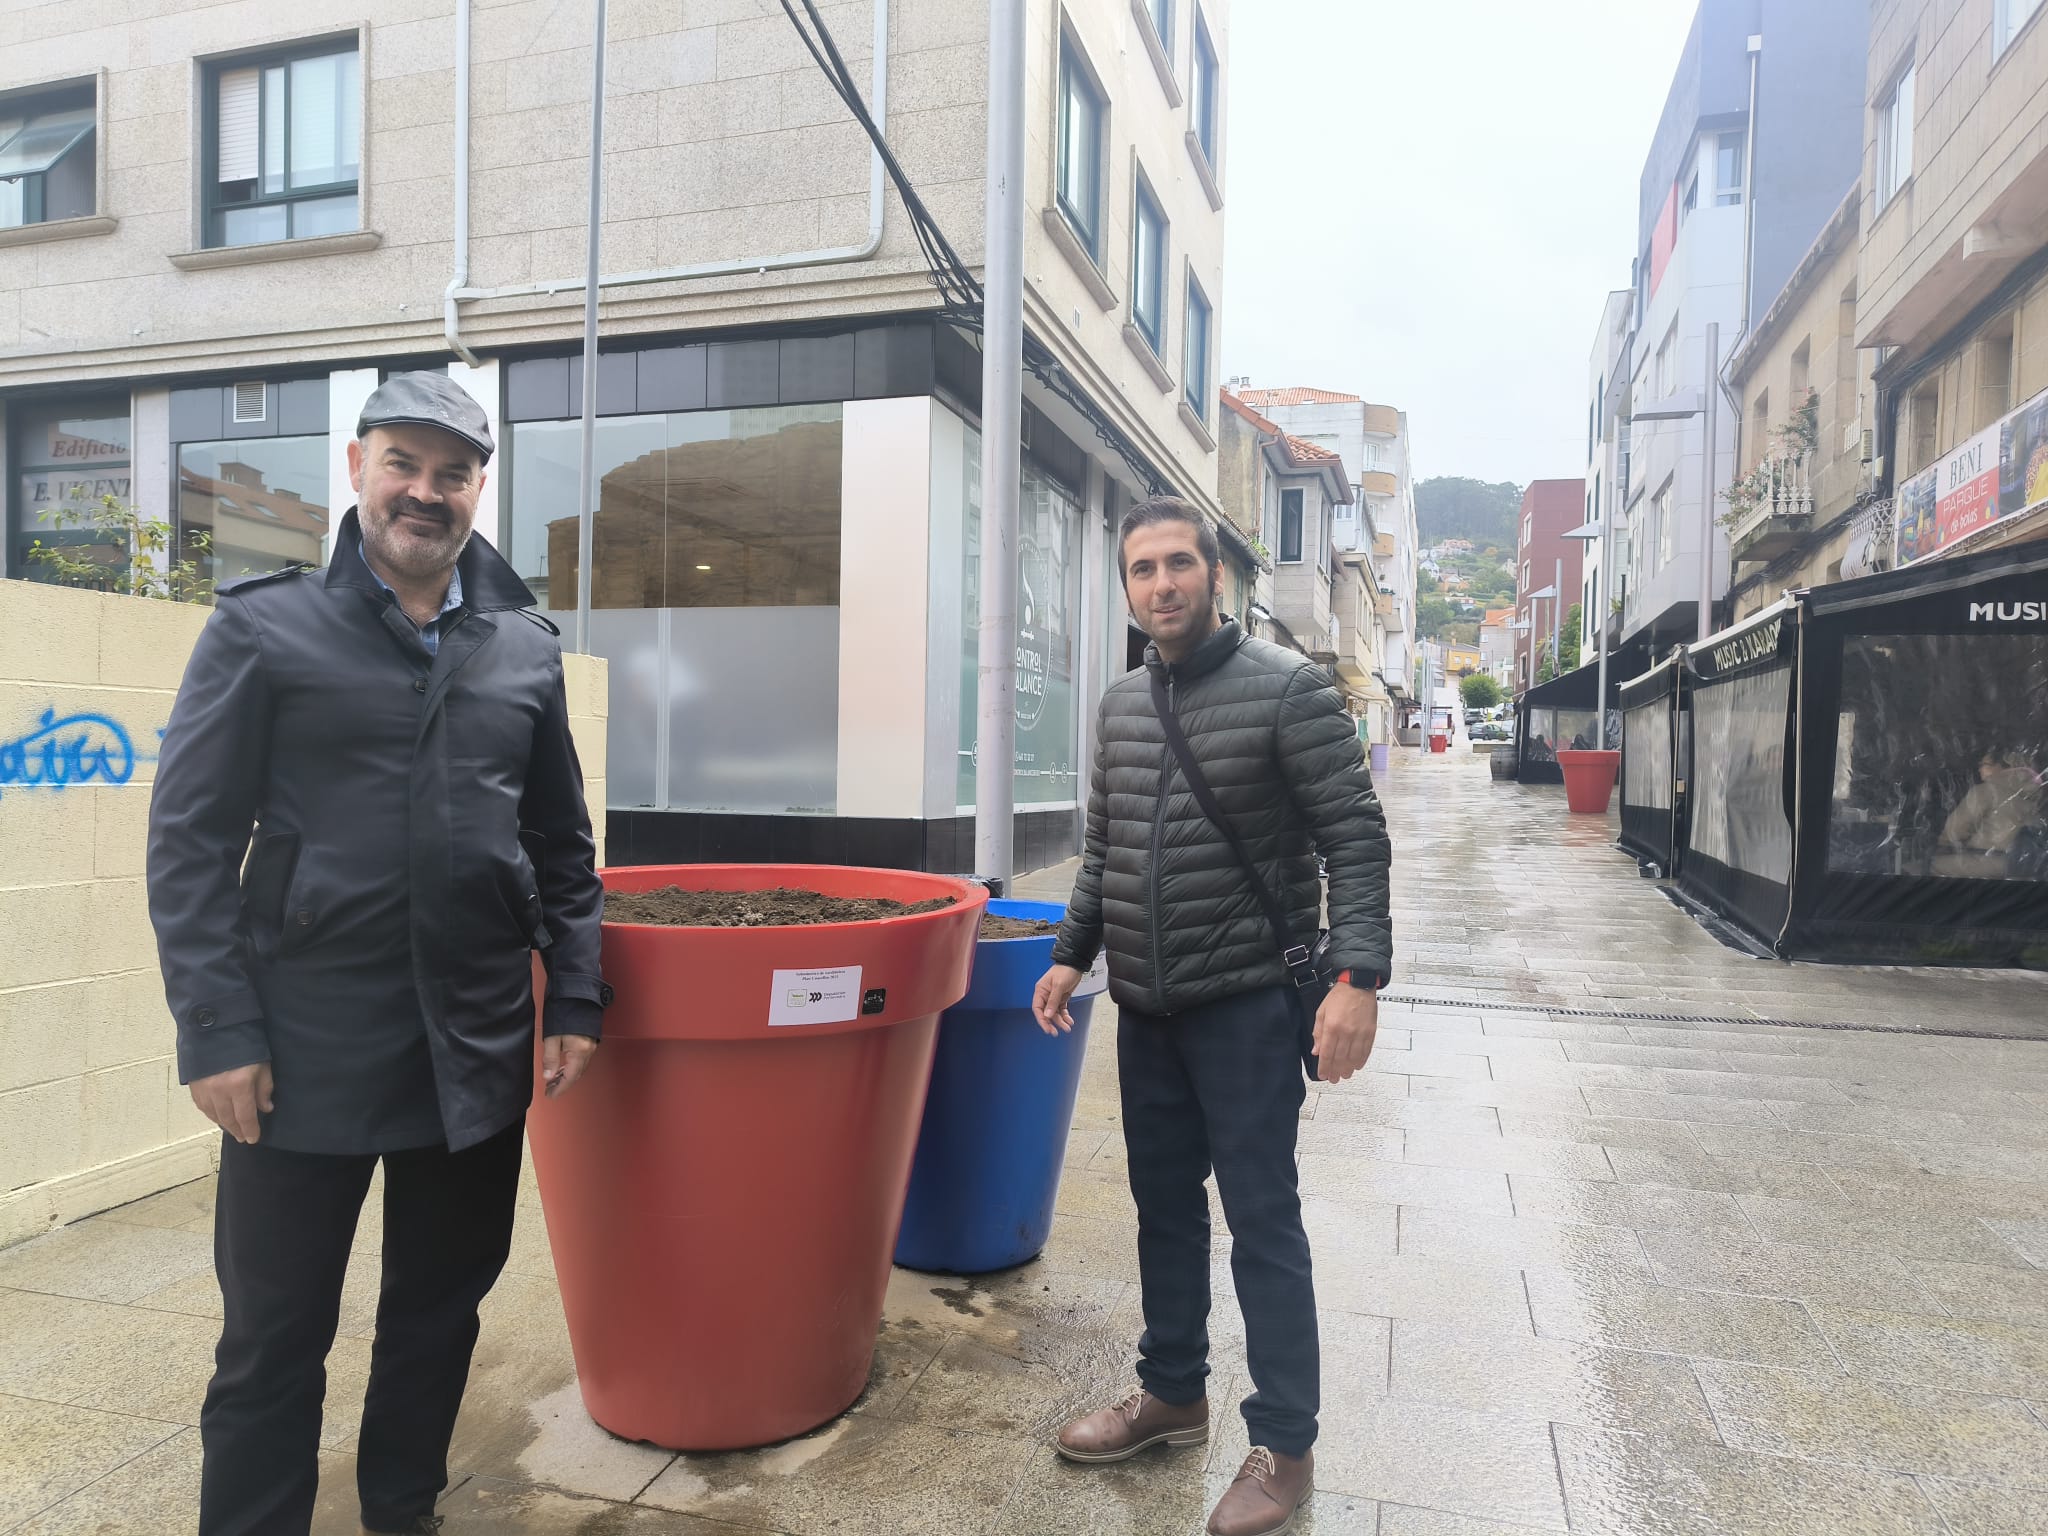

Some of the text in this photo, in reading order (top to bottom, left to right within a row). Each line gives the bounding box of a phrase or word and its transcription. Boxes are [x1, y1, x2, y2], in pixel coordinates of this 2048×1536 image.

[52, 439, 127, 460] Edificio
[1950, 442, 1983, 490] BENI
[34, 482, 51, 502] E.
[1943, 476, 1988, 513] PARQUE
[1969, 601, 2047, 622] MUSI
[1016, 646, 1042, 673] ONTROL
[1713, 641, 1741, 672] MUSIC
[1740, 639, 1749, 662] &
[1015, 671, 1042, 696] ALANCE
